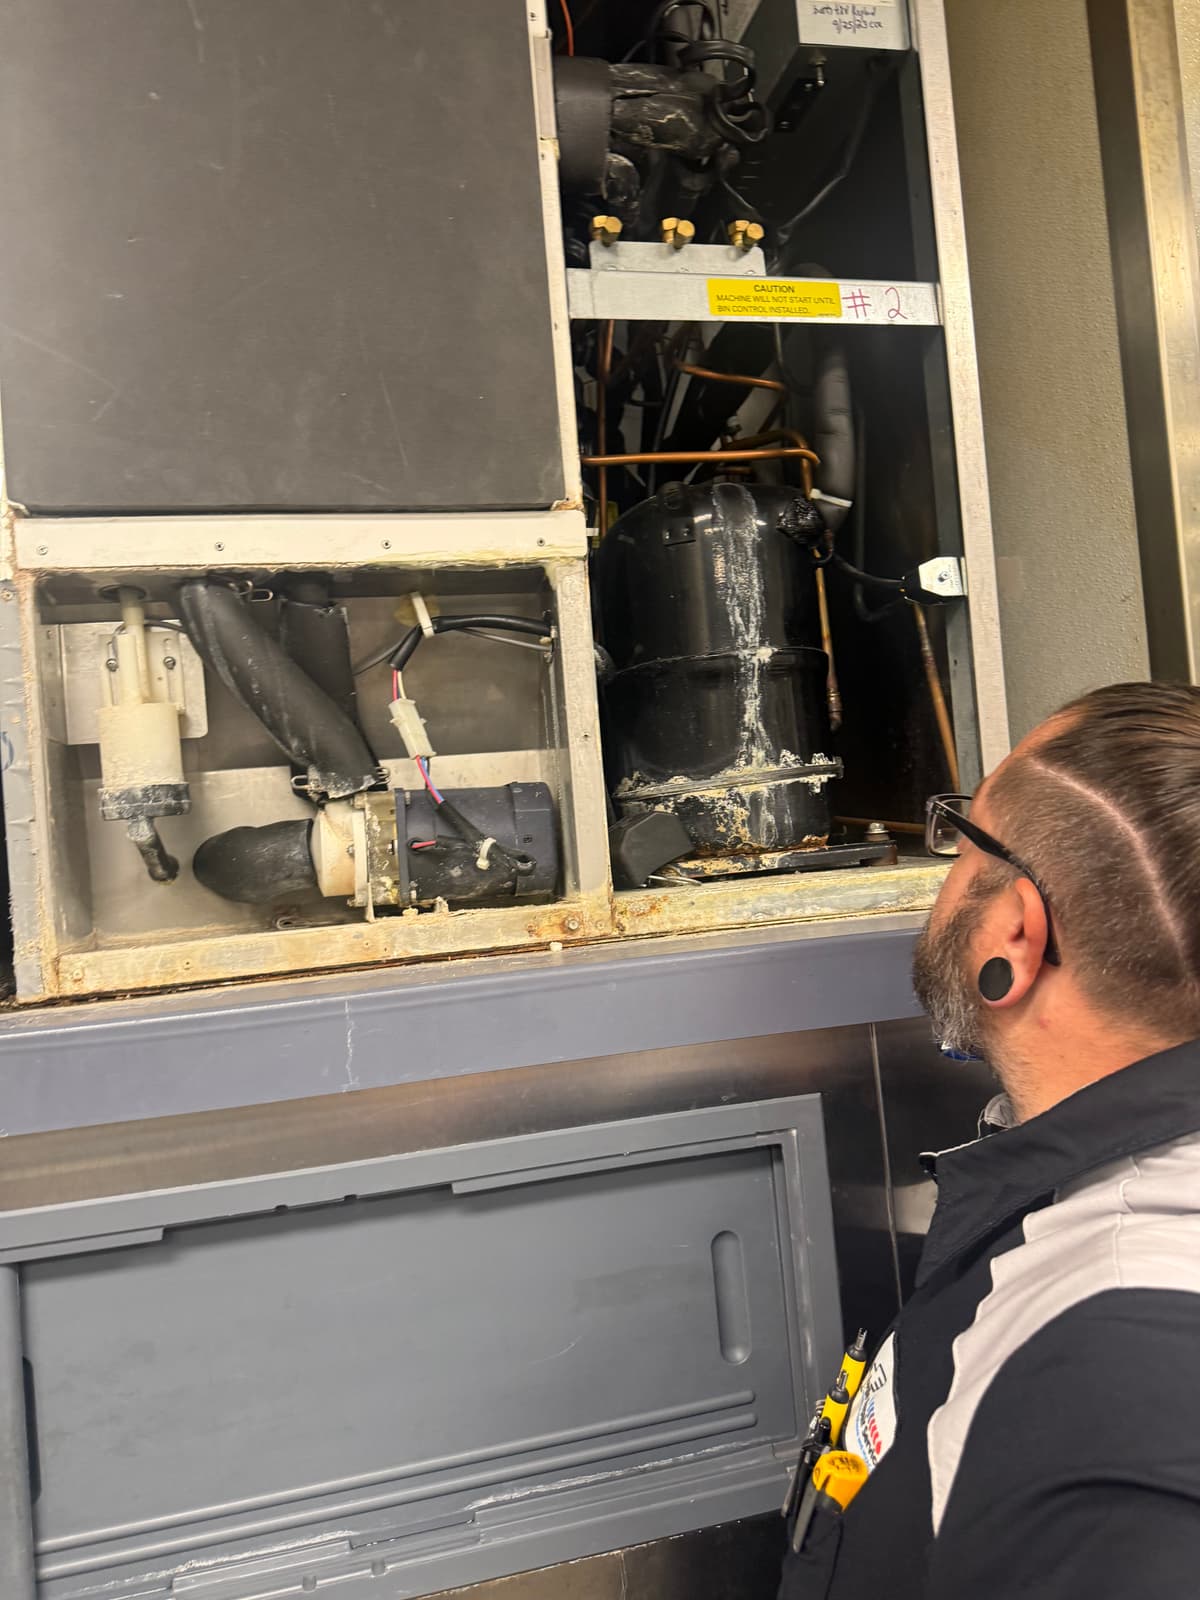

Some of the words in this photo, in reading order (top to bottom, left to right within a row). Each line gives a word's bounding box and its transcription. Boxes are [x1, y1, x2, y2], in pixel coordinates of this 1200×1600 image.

[753, 284, 795, 293] CAUTION
[716, 294, 751, 302] MACHINE
[752, 295, 770, 303] WILL
[789, 296, 811, 304] START
[812, 297, 836, 305] UNTIL
[841, 288, 872, 319] #
[884, 286, 908, 320] 2
[732, 305, 768, 313] CONTROL
